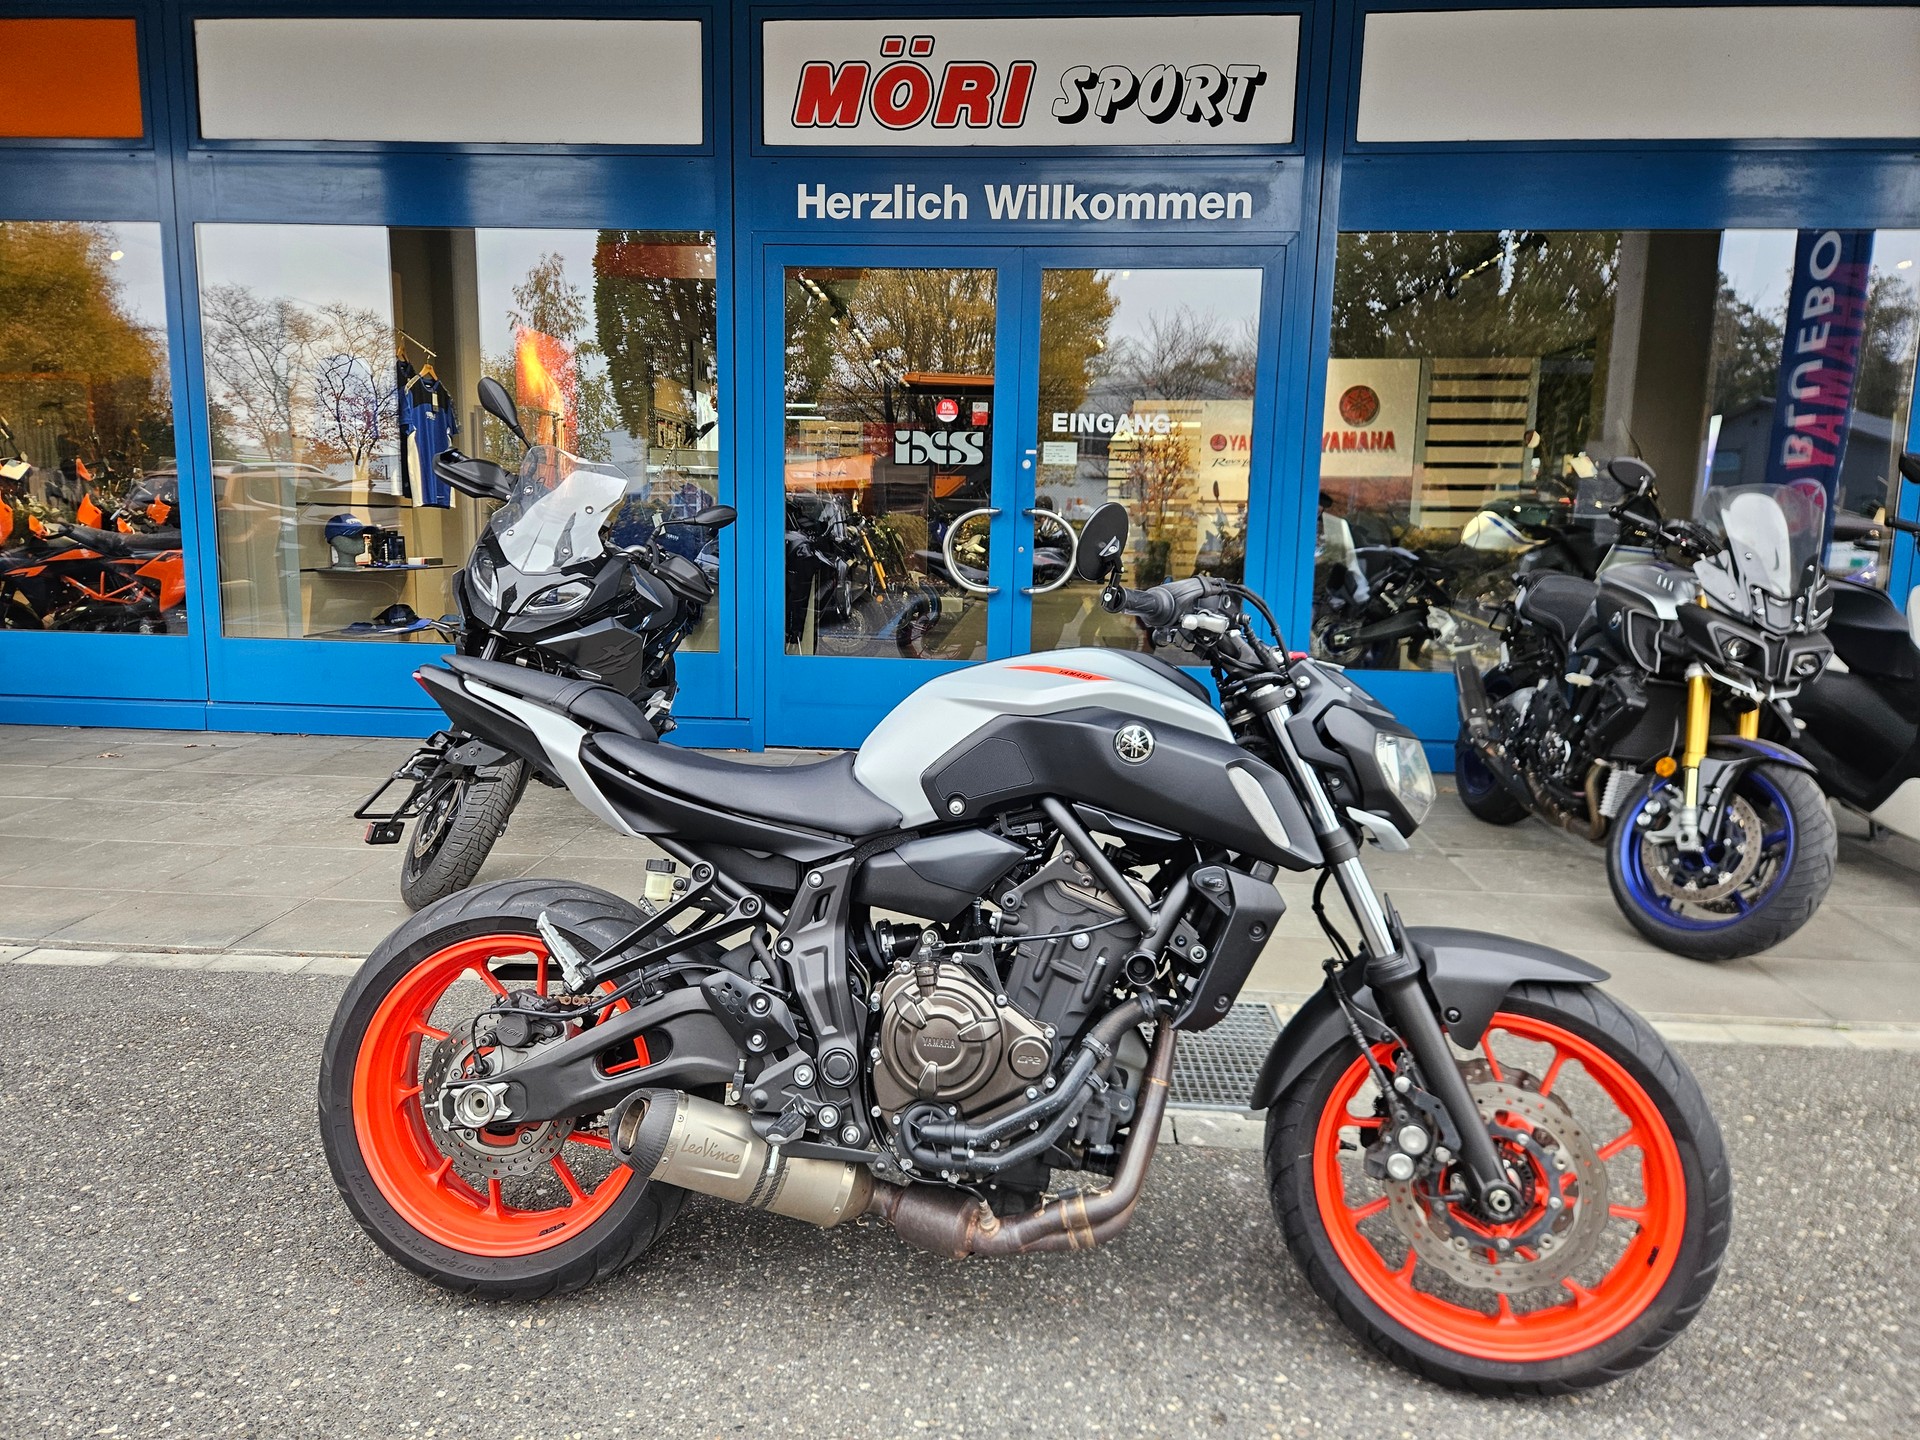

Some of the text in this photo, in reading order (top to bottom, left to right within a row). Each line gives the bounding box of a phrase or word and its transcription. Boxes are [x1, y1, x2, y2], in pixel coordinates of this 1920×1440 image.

[792, 35, 1268, 130] MÖRI SPORT
[797, 183, 1253, 220] Herzlich Willkommen
[1785, 262, 1869, 469] YAMAHA
[1052, 412, 1171, 433] EINGANG
[1058, 669, 1093, 680] YAMAHA
[422, 922, 471, 949] PIRELLI
[922, 1036, 956, 1049] YAMAHA
[681, 1133, 740, 1164] LeoVince
